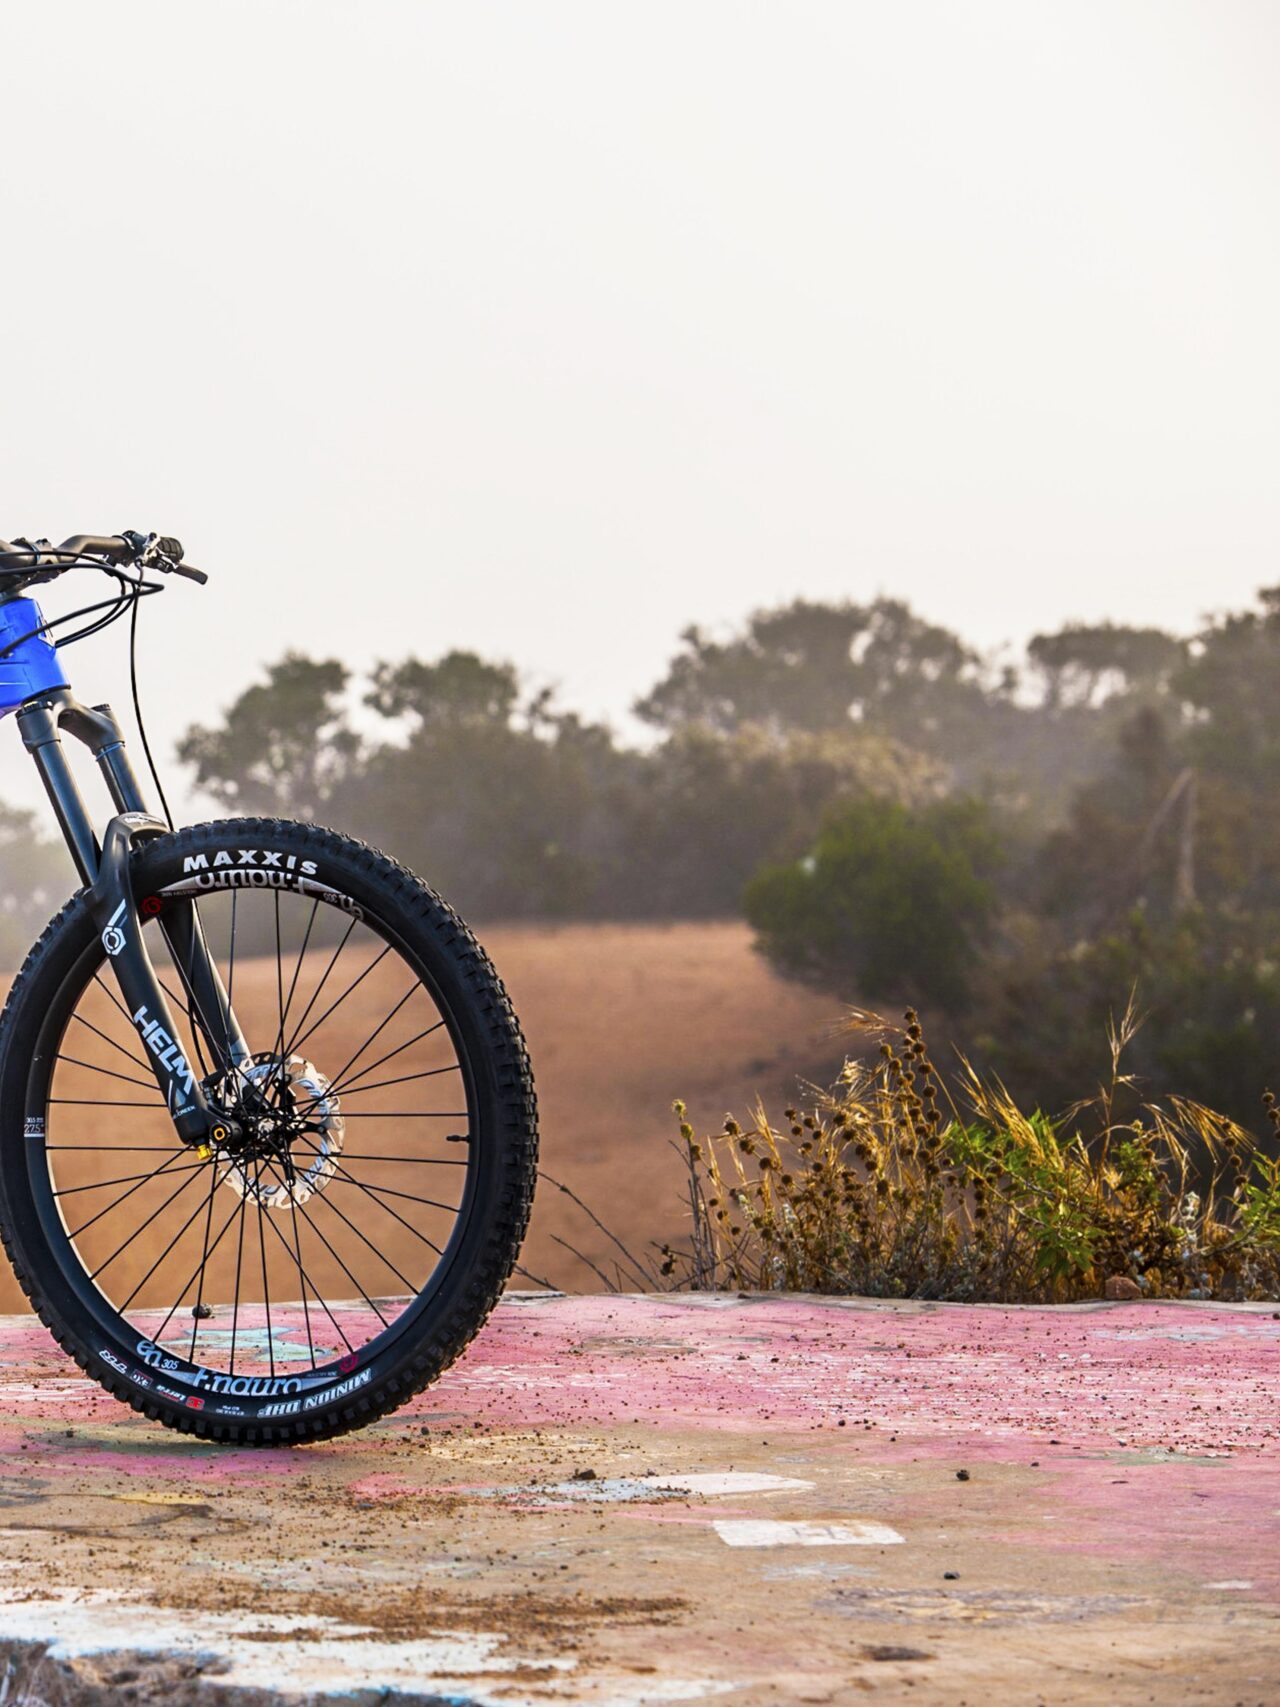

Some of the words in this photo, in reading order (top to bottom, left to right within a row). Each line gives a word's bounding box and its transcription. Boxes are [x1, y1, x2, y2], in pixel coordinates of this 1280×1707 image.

[183, 850, 319, 875] MAXXIS
[133, 1005, 194, 1096] HELM
[161, 1358, 180, 1370] 305
[302, 1368, 372, 1411] MINION
